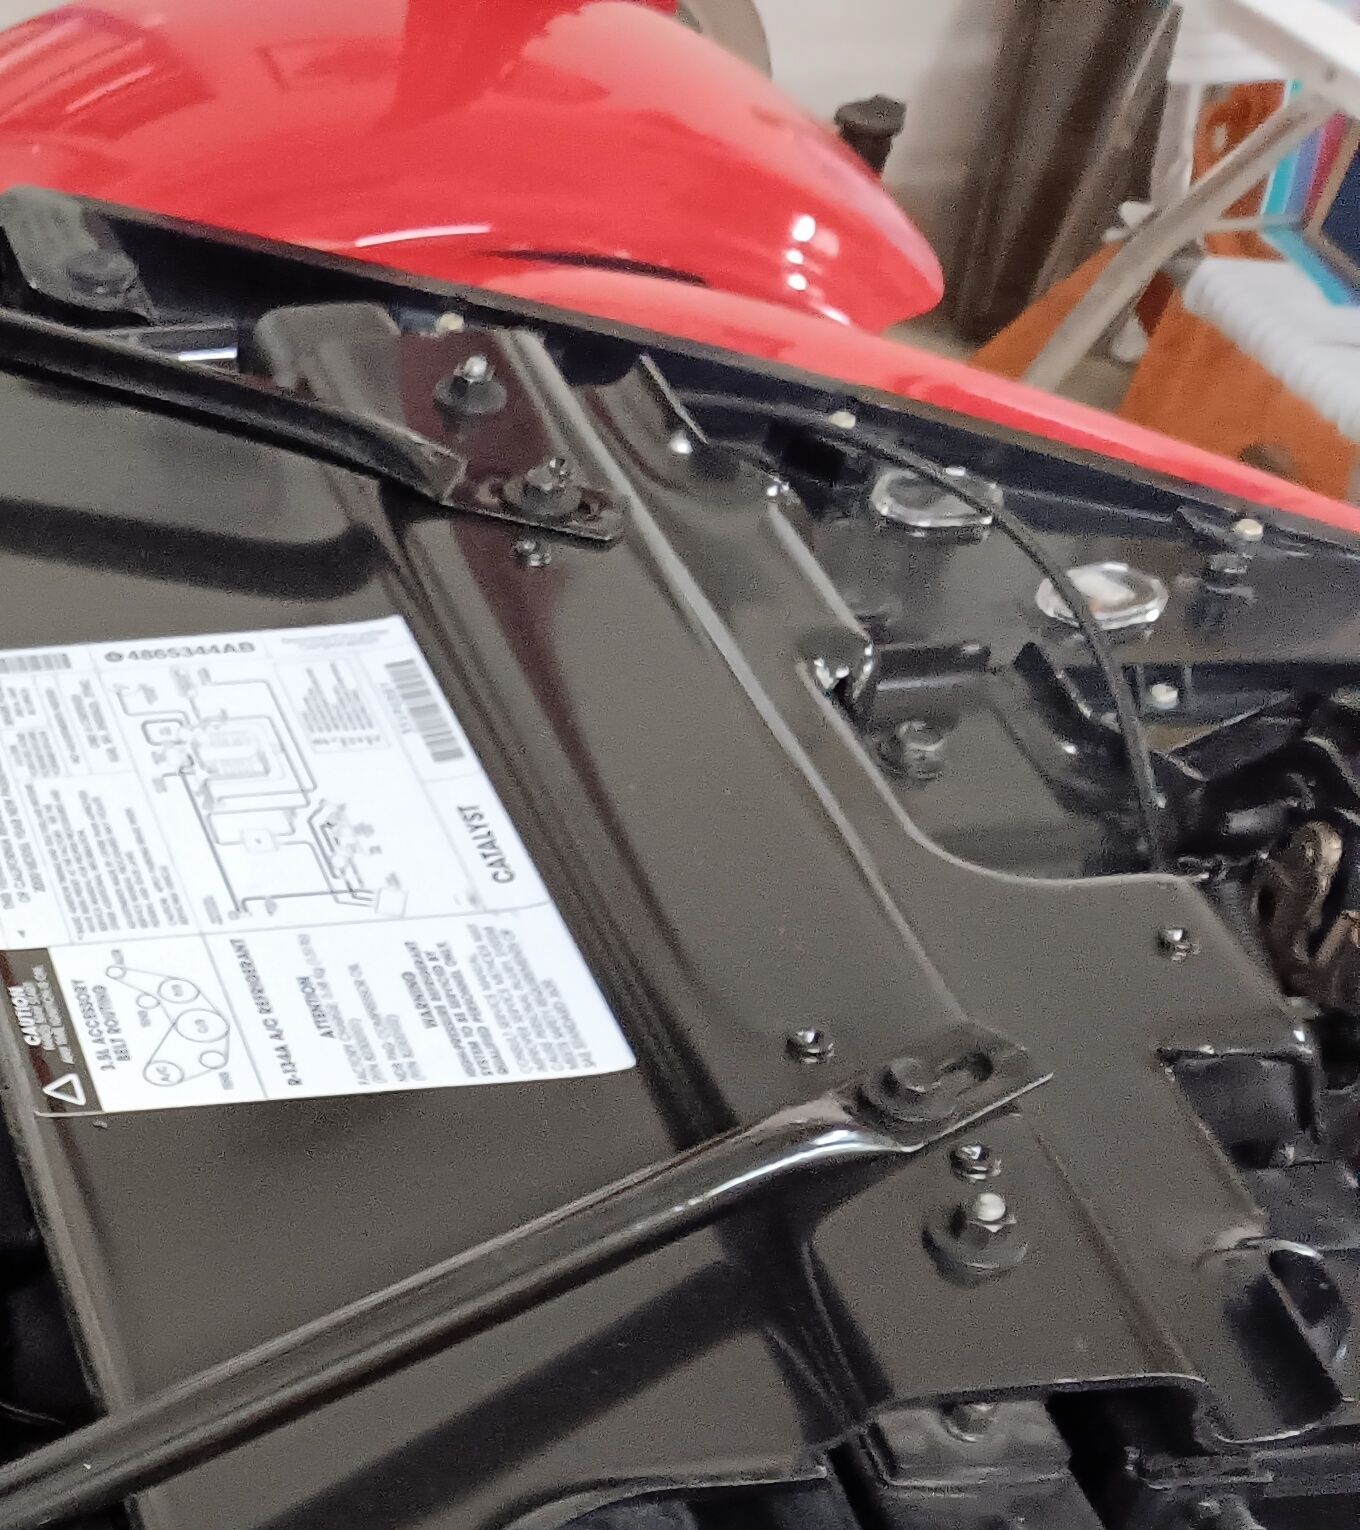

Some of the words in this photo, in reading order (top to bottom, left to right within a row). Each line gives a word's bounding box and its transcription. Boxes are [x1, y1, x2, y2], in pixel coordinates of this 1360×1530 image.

[455, 804, 517, 883] CATALYST
[228, 937, 274, 1014] REFRIGERANT
[399, 970, 439, 1028] WARNING
[403, 941, 443, 1001] REFRIGERANT
[430, 964, 462, 1009] SERVICED
[447, 969, 485, 1023] PERSONNEL
[7, 984, 42, 1046] CAUTION
[69, 978, 106, 1045] ACCESSORY
[91, 984, 122, 1034] ROUTING
[260, 1017, 286, 1041] A/C
[294, 976, 335, 1038] ATTENTION
[109, 1037, 131, 1061] BELT
[270, 1043, 303, 1086] R-134A
[433, 1004, 478, 1078] HIGH-PRESSURE
[465, 1040, 494, 1076] SYSTEM
[474, 1025, 510, 1075] QUALIFIED
